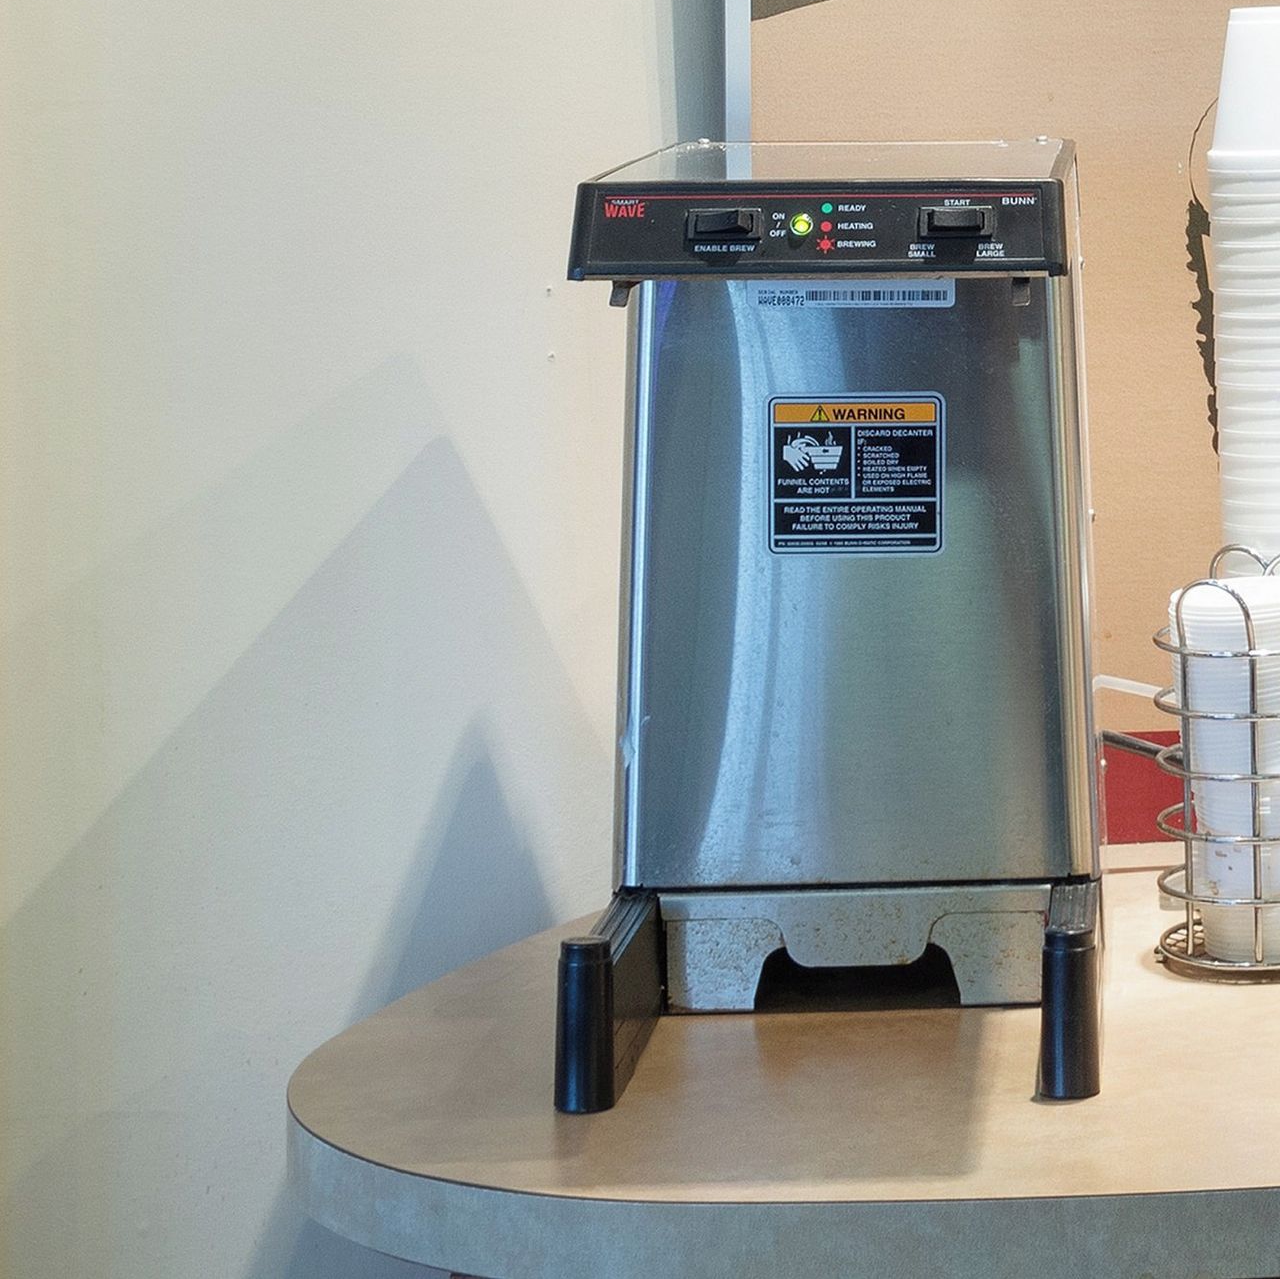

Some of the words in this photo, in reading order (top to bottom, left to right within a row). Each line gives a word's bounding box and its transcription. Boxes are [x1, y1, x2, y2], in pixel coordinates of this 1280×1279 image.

[1001, 197, 1035, 206] BUNN
[604, 202, 645, 218] WAVE
[769, 230, 787, 238] OFF
[836, 240, 877, 248] BREWING
[909, 243, 936, 251] BREW
[694, 245, 728, 253] ENABLE
[729, 244, 756, 252] BREW
[907, 250, 937, 258] SMALL
[832, 408, 906, 421] WARNING
[857, 429, 891, 437] DISCARD
[892, 429, 933, 437] DECANTER
[777, 478, 808, 486] FUNNEL
[808, 477, 850, 486] CONTENTS
[783, 506, 806, 514] READ
[850, 505, 894, 513] OPERATING
[895, 505, 927, 513] MANUAL
[874, 513, 911, 521] PRODUCT
[836, 522, 866, 530] COMPLY
[867, 522, 891, 530] RISKS
[891, 522, 919, 530] INJURY
